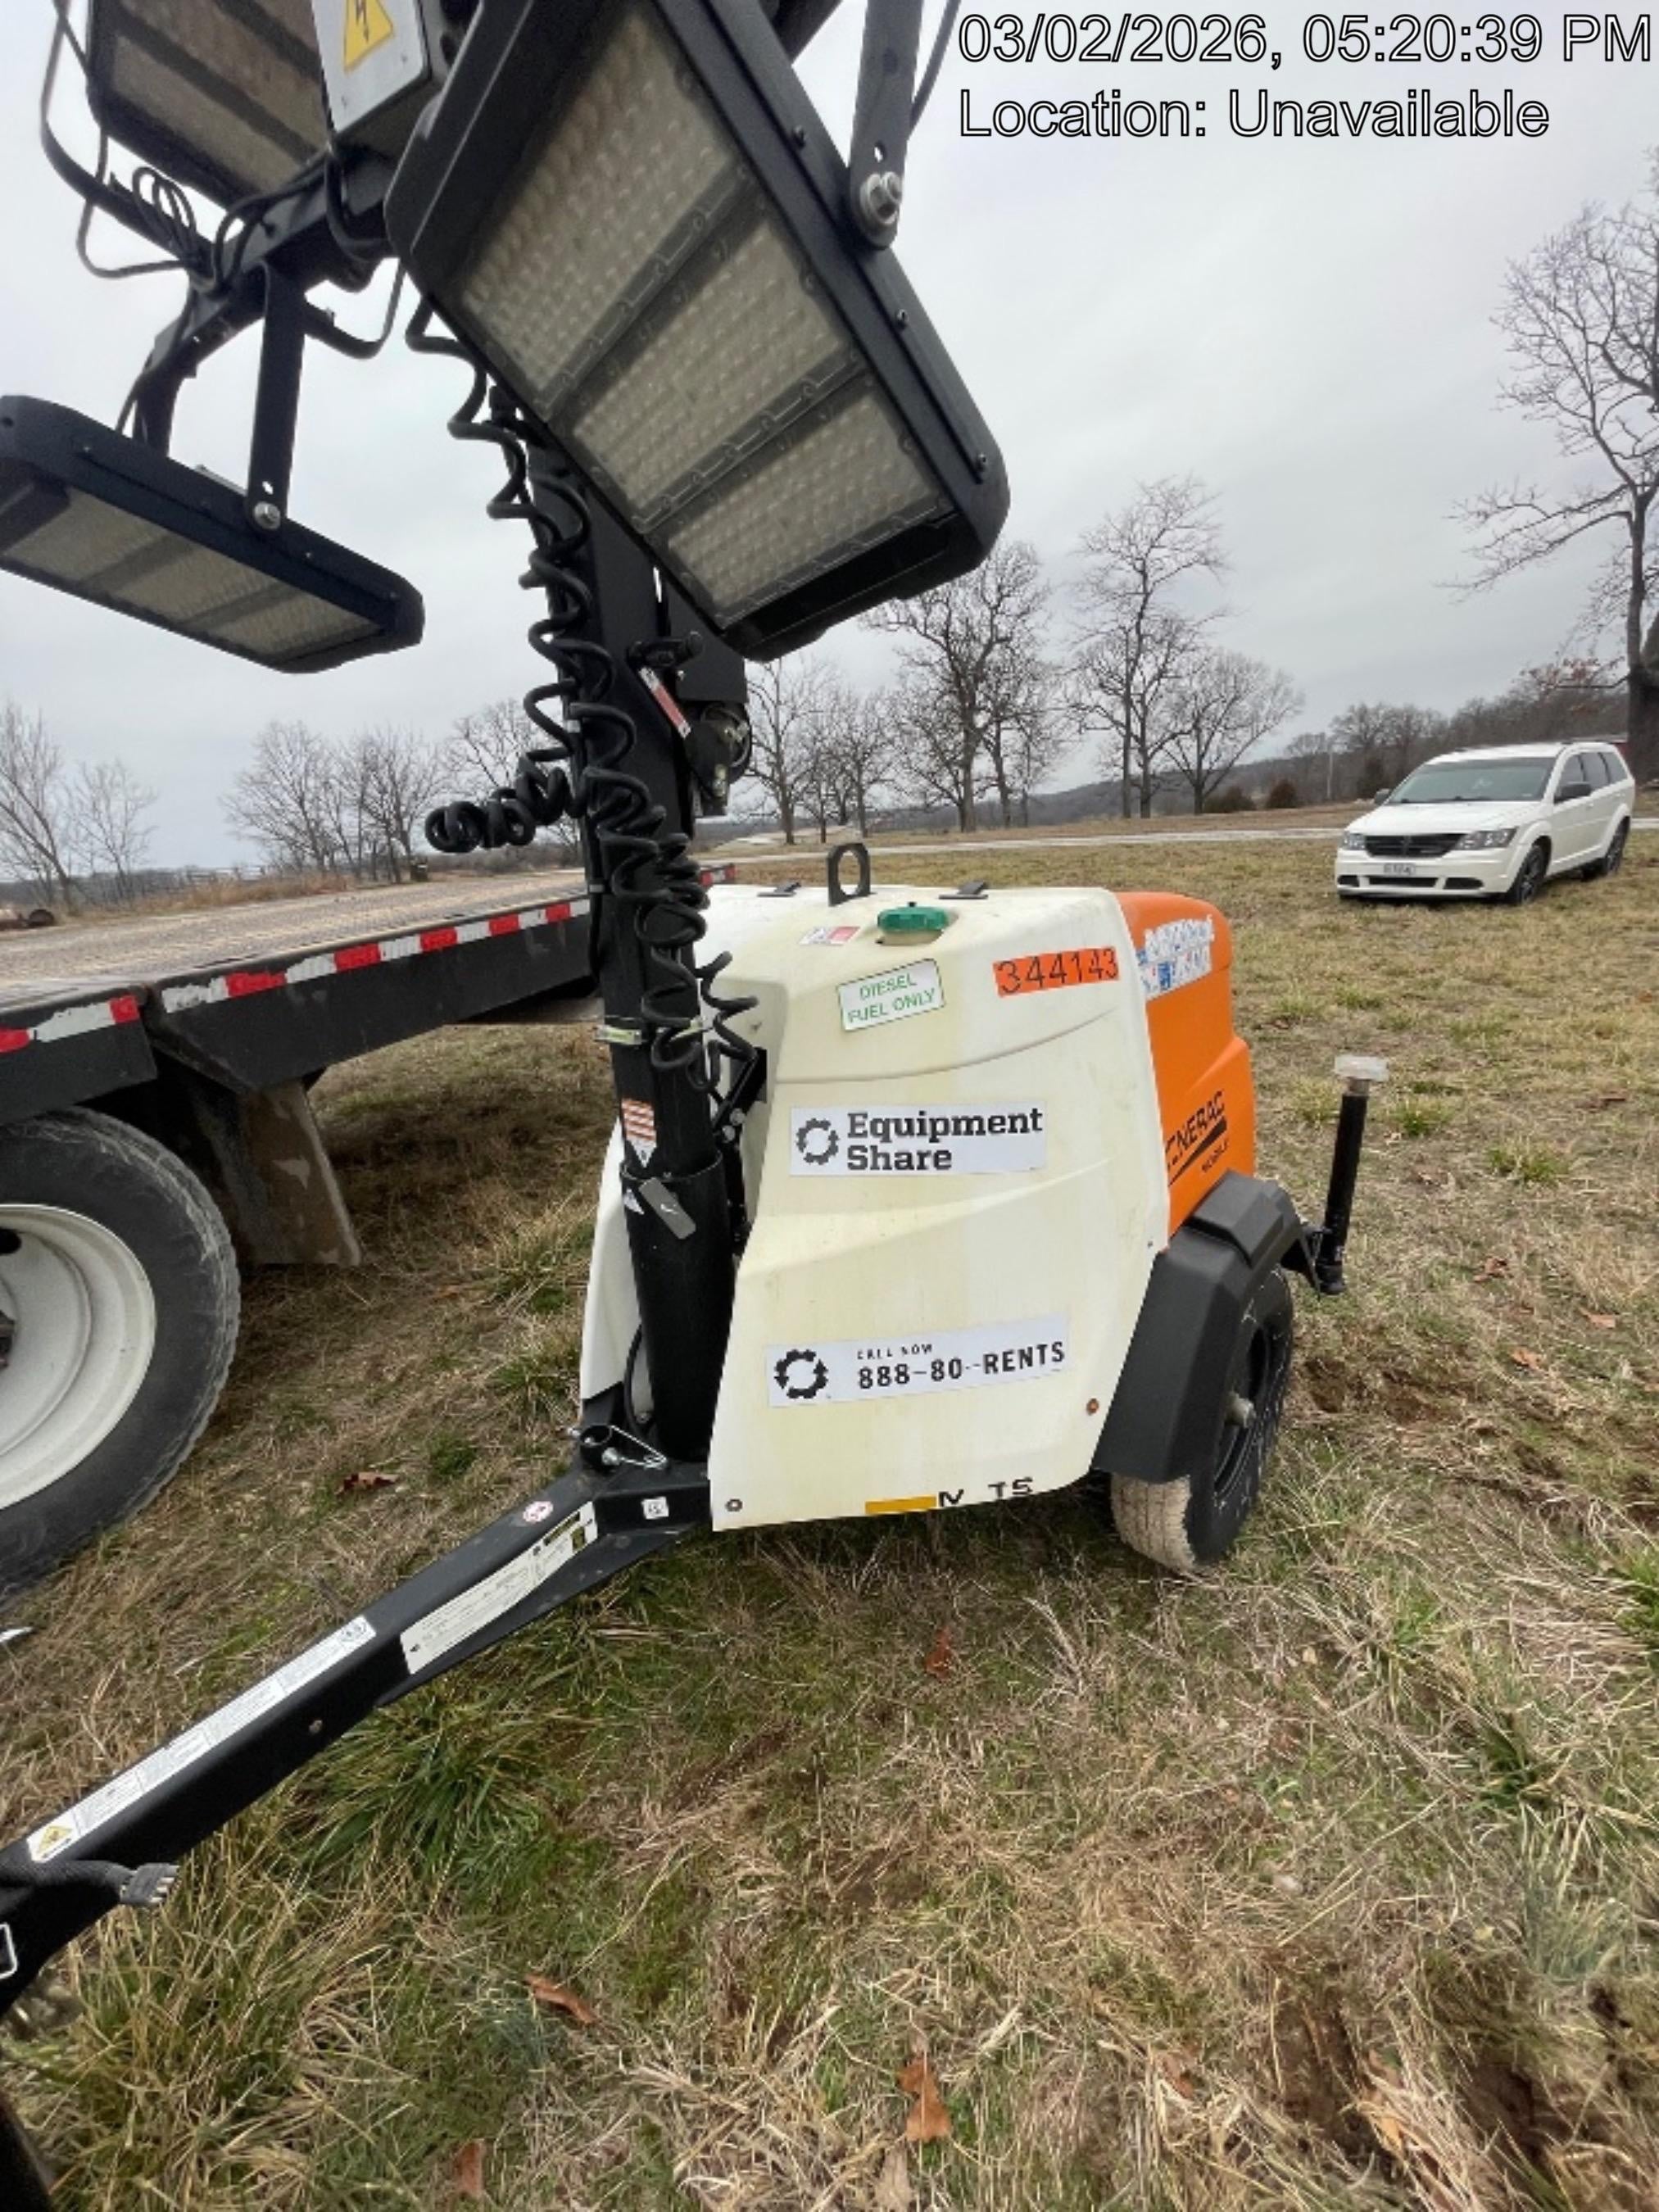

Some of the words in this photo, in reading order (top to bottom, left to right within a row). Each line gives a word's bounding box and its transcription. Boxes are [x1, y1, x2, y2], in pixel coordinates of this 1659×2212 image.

[859, 972, 917, 1000] DIESEL
[997, 947, 1119, 994] 344143
[847, 1002, 889, 1023] FUEL
[892, 987, 935, 1011] ONLY
[846, 1108, 1043, 1144] Equipment
[846, 1145, 952, 1172] Share
